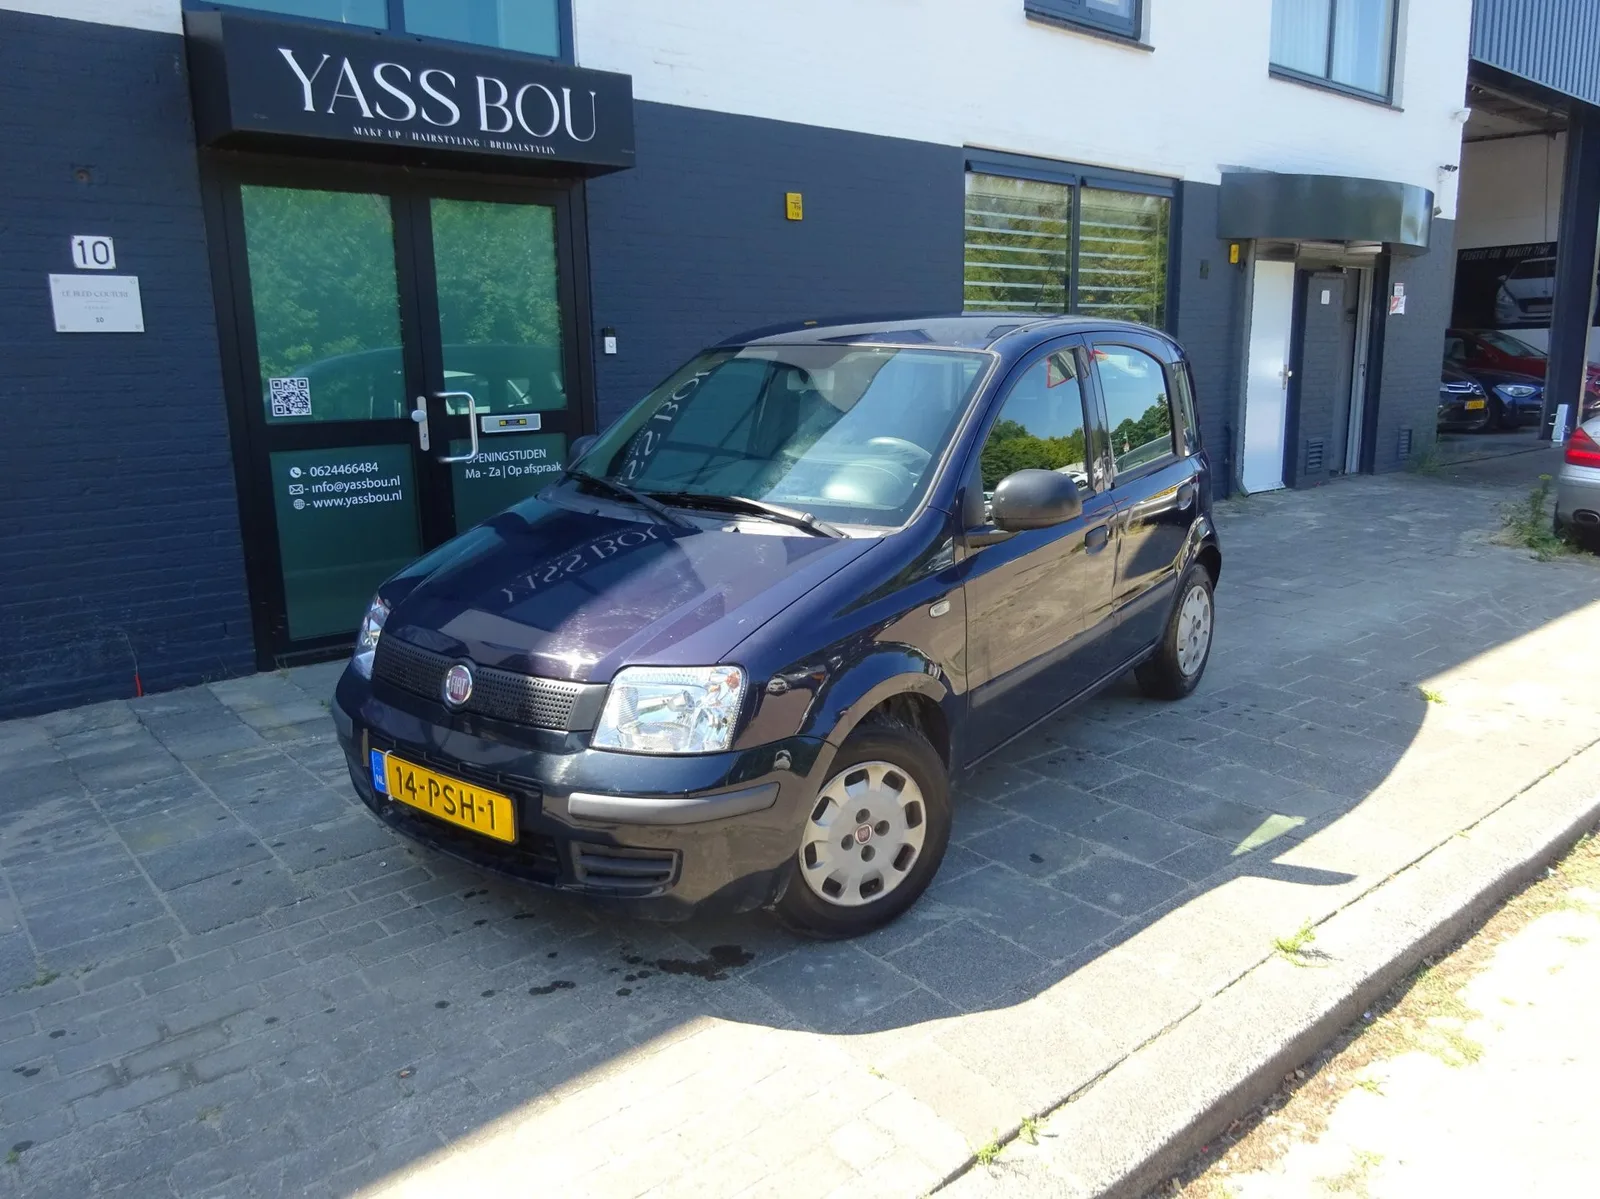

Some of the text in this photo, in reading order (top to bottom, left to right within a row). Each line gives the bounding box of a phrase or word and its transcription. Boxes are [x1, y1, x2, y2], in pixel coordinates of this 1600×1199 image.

[278, 47, 597, 143] YASS BOU
[388, 129, 401, 139] UP
[412, 132, 480, 147] HAIRSTYLING
[77, 240, 110, 265] 10
[309, 461, 379, 477] 0624466484
[465, 468, 481, 479] Ma
[488, 466, 501, 477] Za
[507, 465, 522, 477] Op
[524, 462, 562, 475] afspraak
[312, 475, 401, 493] info@yassbou.nl
[313, 490, 403, 508] www.yassbou.nl
[450, 675, 469, 696] FIAT
[396, 766, 497, 830] 14-PSH-1
